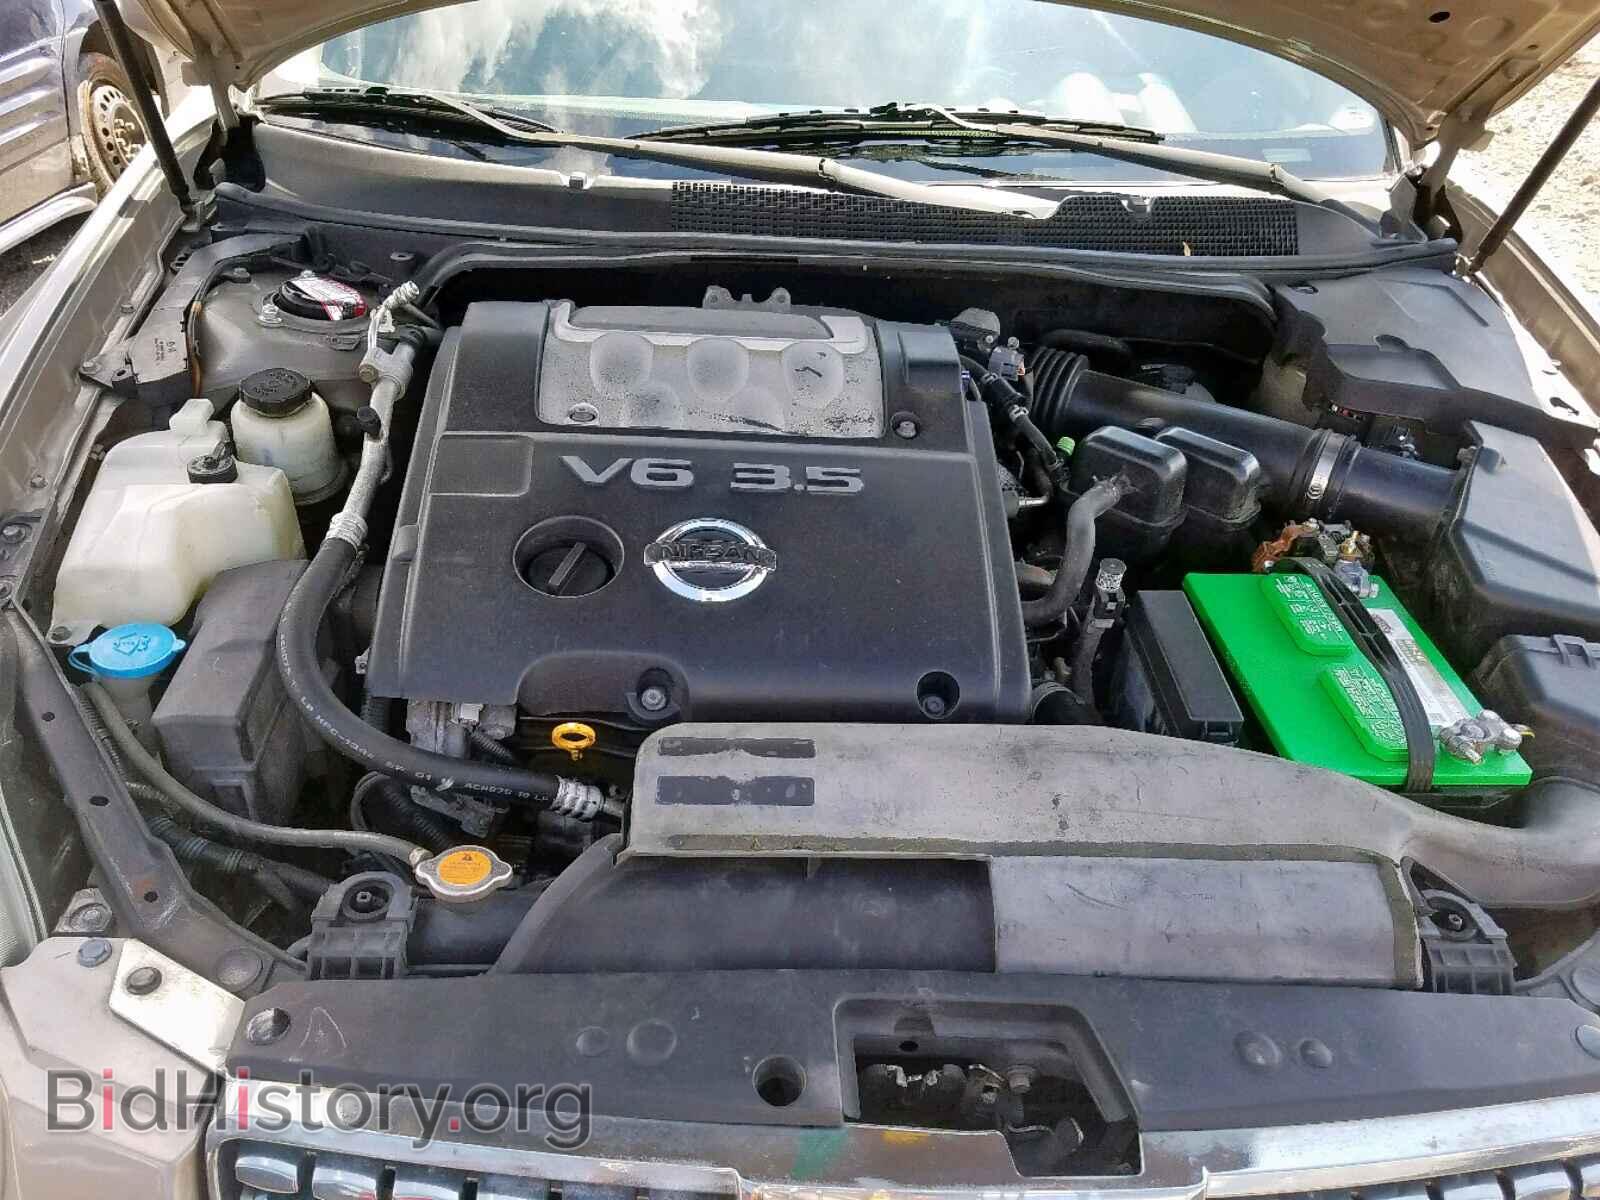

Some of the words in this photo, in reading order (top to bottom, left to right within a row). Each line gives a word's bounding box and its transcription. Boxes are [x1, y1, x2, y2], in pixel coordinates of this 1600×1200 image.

[560, 455, 695, 488] V6
[730, 462, 865, 495] 3.5
[658, 542, 762, 565] NISSAN
